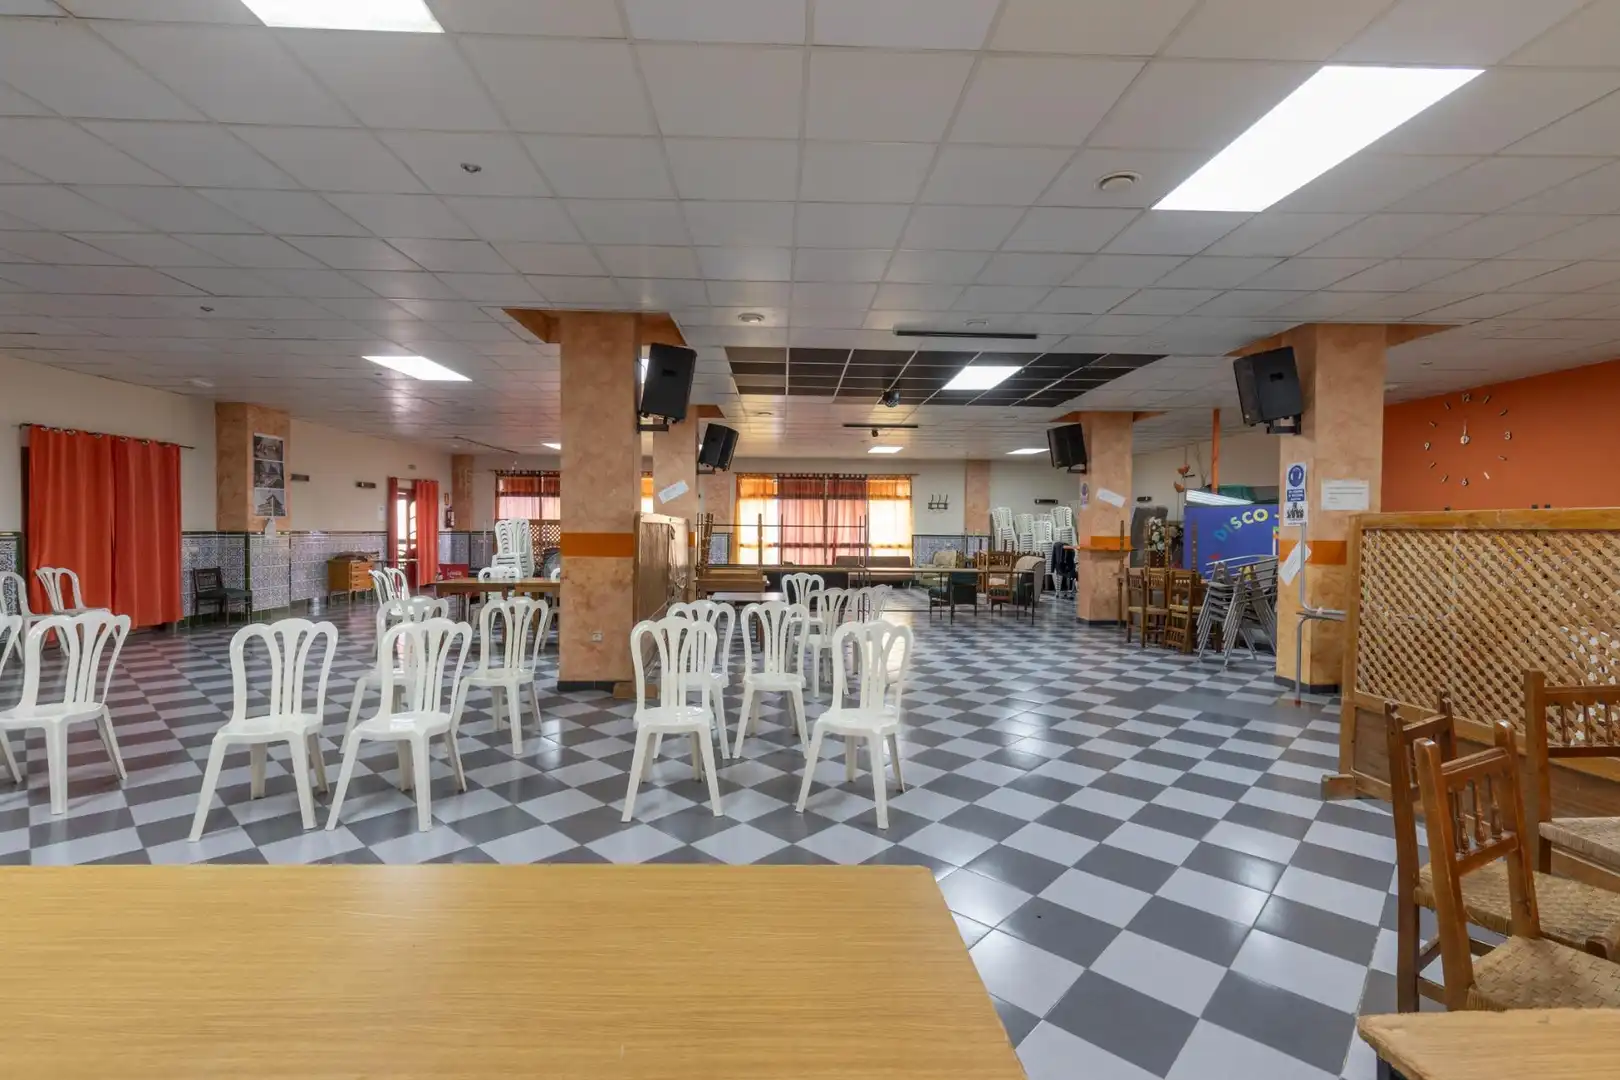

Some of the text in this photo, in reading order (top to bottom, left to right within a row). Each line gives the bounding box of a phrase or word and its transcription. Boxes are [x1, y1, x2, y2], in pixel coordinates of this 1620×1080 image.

[1504, 432, 1511, 440] 3
[1424, 442, 1430, 450] 9
[1462, 478, 1467, 486] 6
[1214, 509, 1268, 542] DISCO
